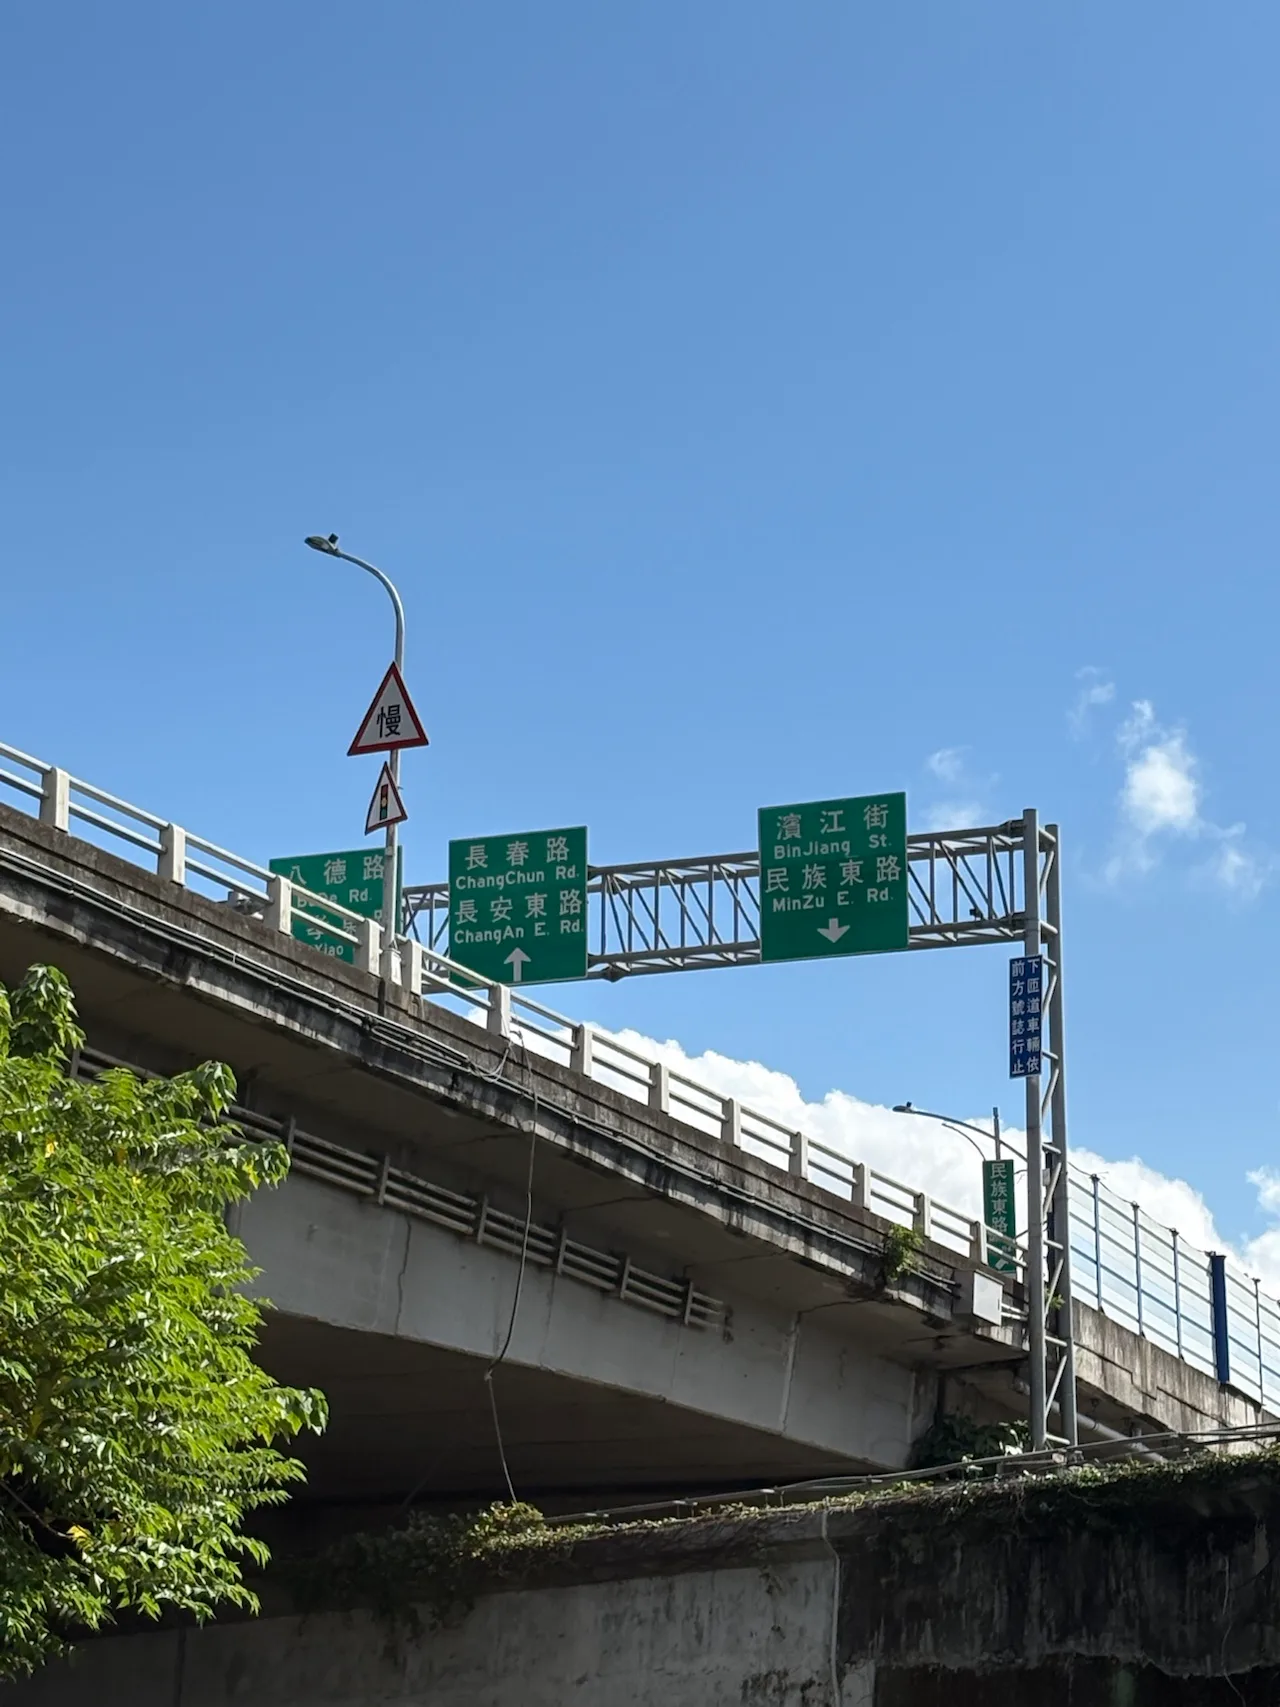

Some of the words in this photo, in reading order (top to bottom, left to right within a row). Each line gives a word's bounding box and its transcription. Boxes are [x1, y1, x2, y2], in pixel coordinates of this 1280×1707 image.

[376, 704, 401, 738] 慢
[776, 803, 889, 841] 濱江街
[465, 836, 570, 870] 長春路
[774, 840, 851, 860] BinJiang
[868, 834, 892, 849] St.
[289, 854, 385, 886] 八德路
[455, 870, 545, 891] ChangChun
[555, 865, 580, 880] Rd.
[765, 855, 902, 894] 民族東路
[454, 888, 583, 925] 長安東路
[772, 894, 825, 913] MinZu
[836, 891, 855, 906] E.
[866, 887, 894, 903] Rd.
[454, 925, 525, 945] ChangAn
[534, 922, 550, 937] E.
[560, 919, 584, 934] Rd.
[990, 1162, 1008, 1234] 民族東路
